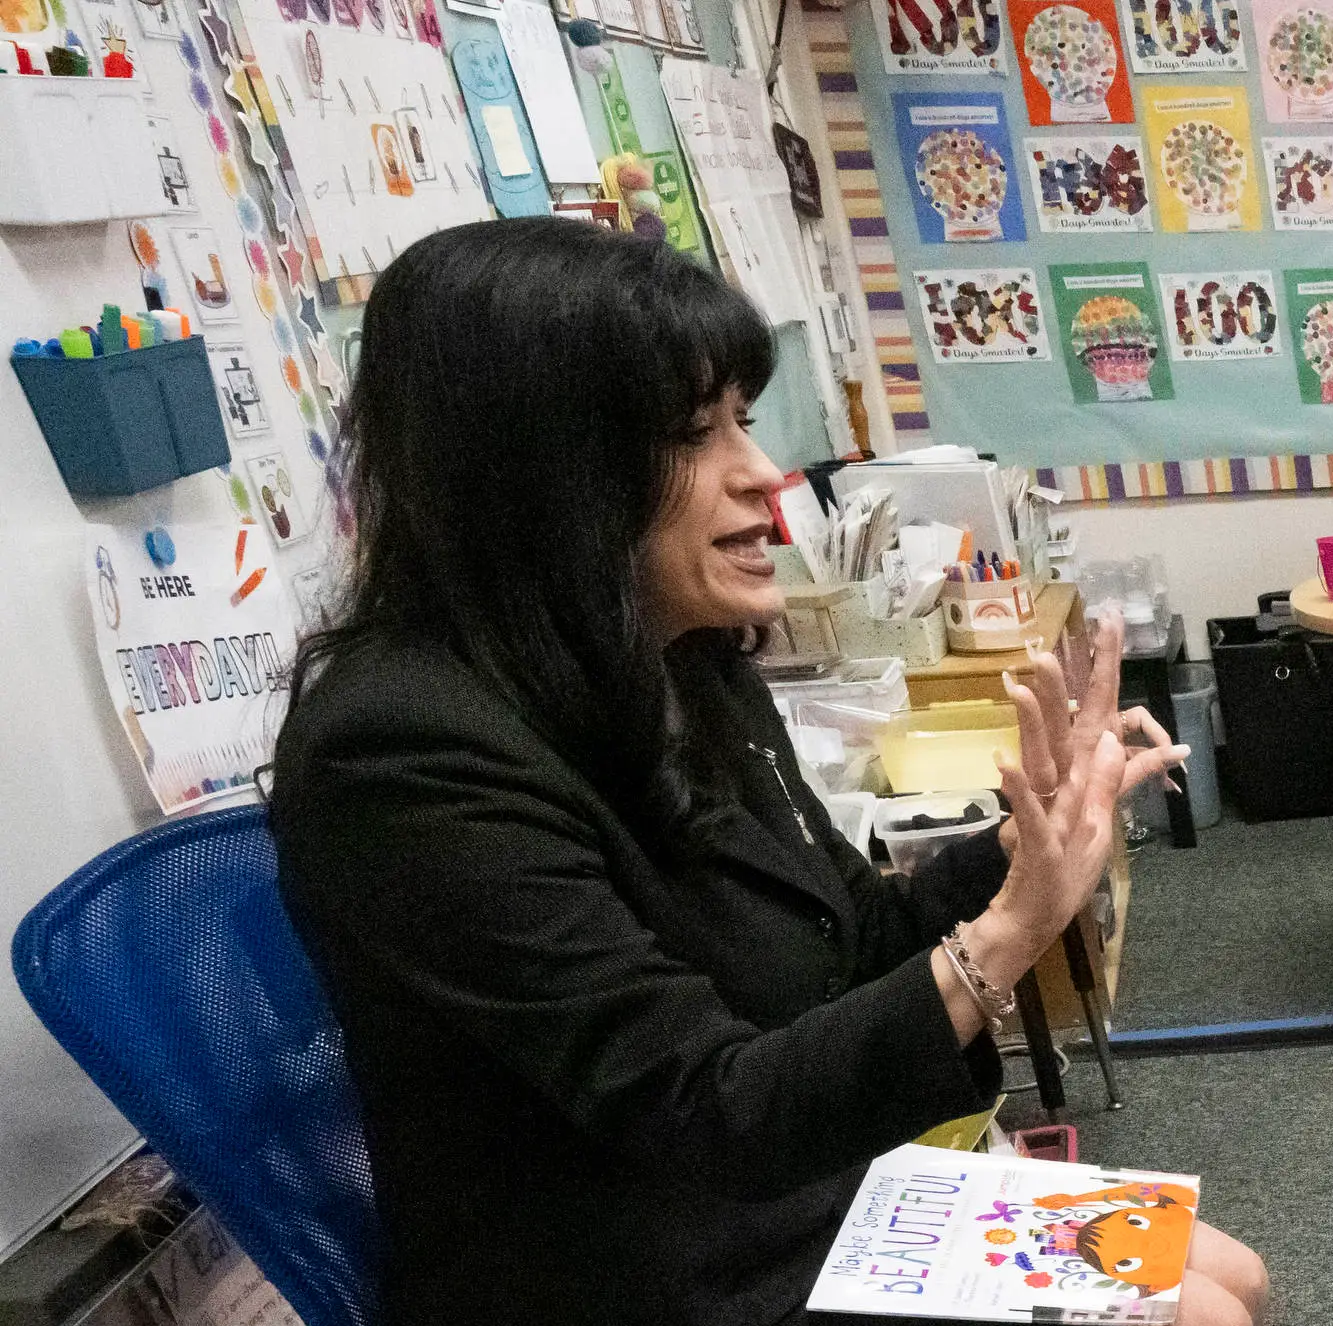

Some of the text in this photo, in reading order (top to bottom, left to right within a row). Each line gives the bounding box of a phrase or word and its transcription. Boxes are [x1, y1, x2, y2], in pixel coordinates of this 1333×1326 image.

[911, 58, 987, 70] Days Smarter!
[1154, 58, 1225, 70] Days Smarter!
[1060, 218, 1131, 229] Days Smarter!
[1294, 217, 1317, 226] Days
[952, 348, 1024, 359] Days Smarter!
[1195, 347, 1261, 358] Days Smarter!
[140, 575, 196, 599] BE HERE
[828, 1176, 905, 1277] Maybe Something
[869, 1173, 967, 1295] BEAUTIFUL
